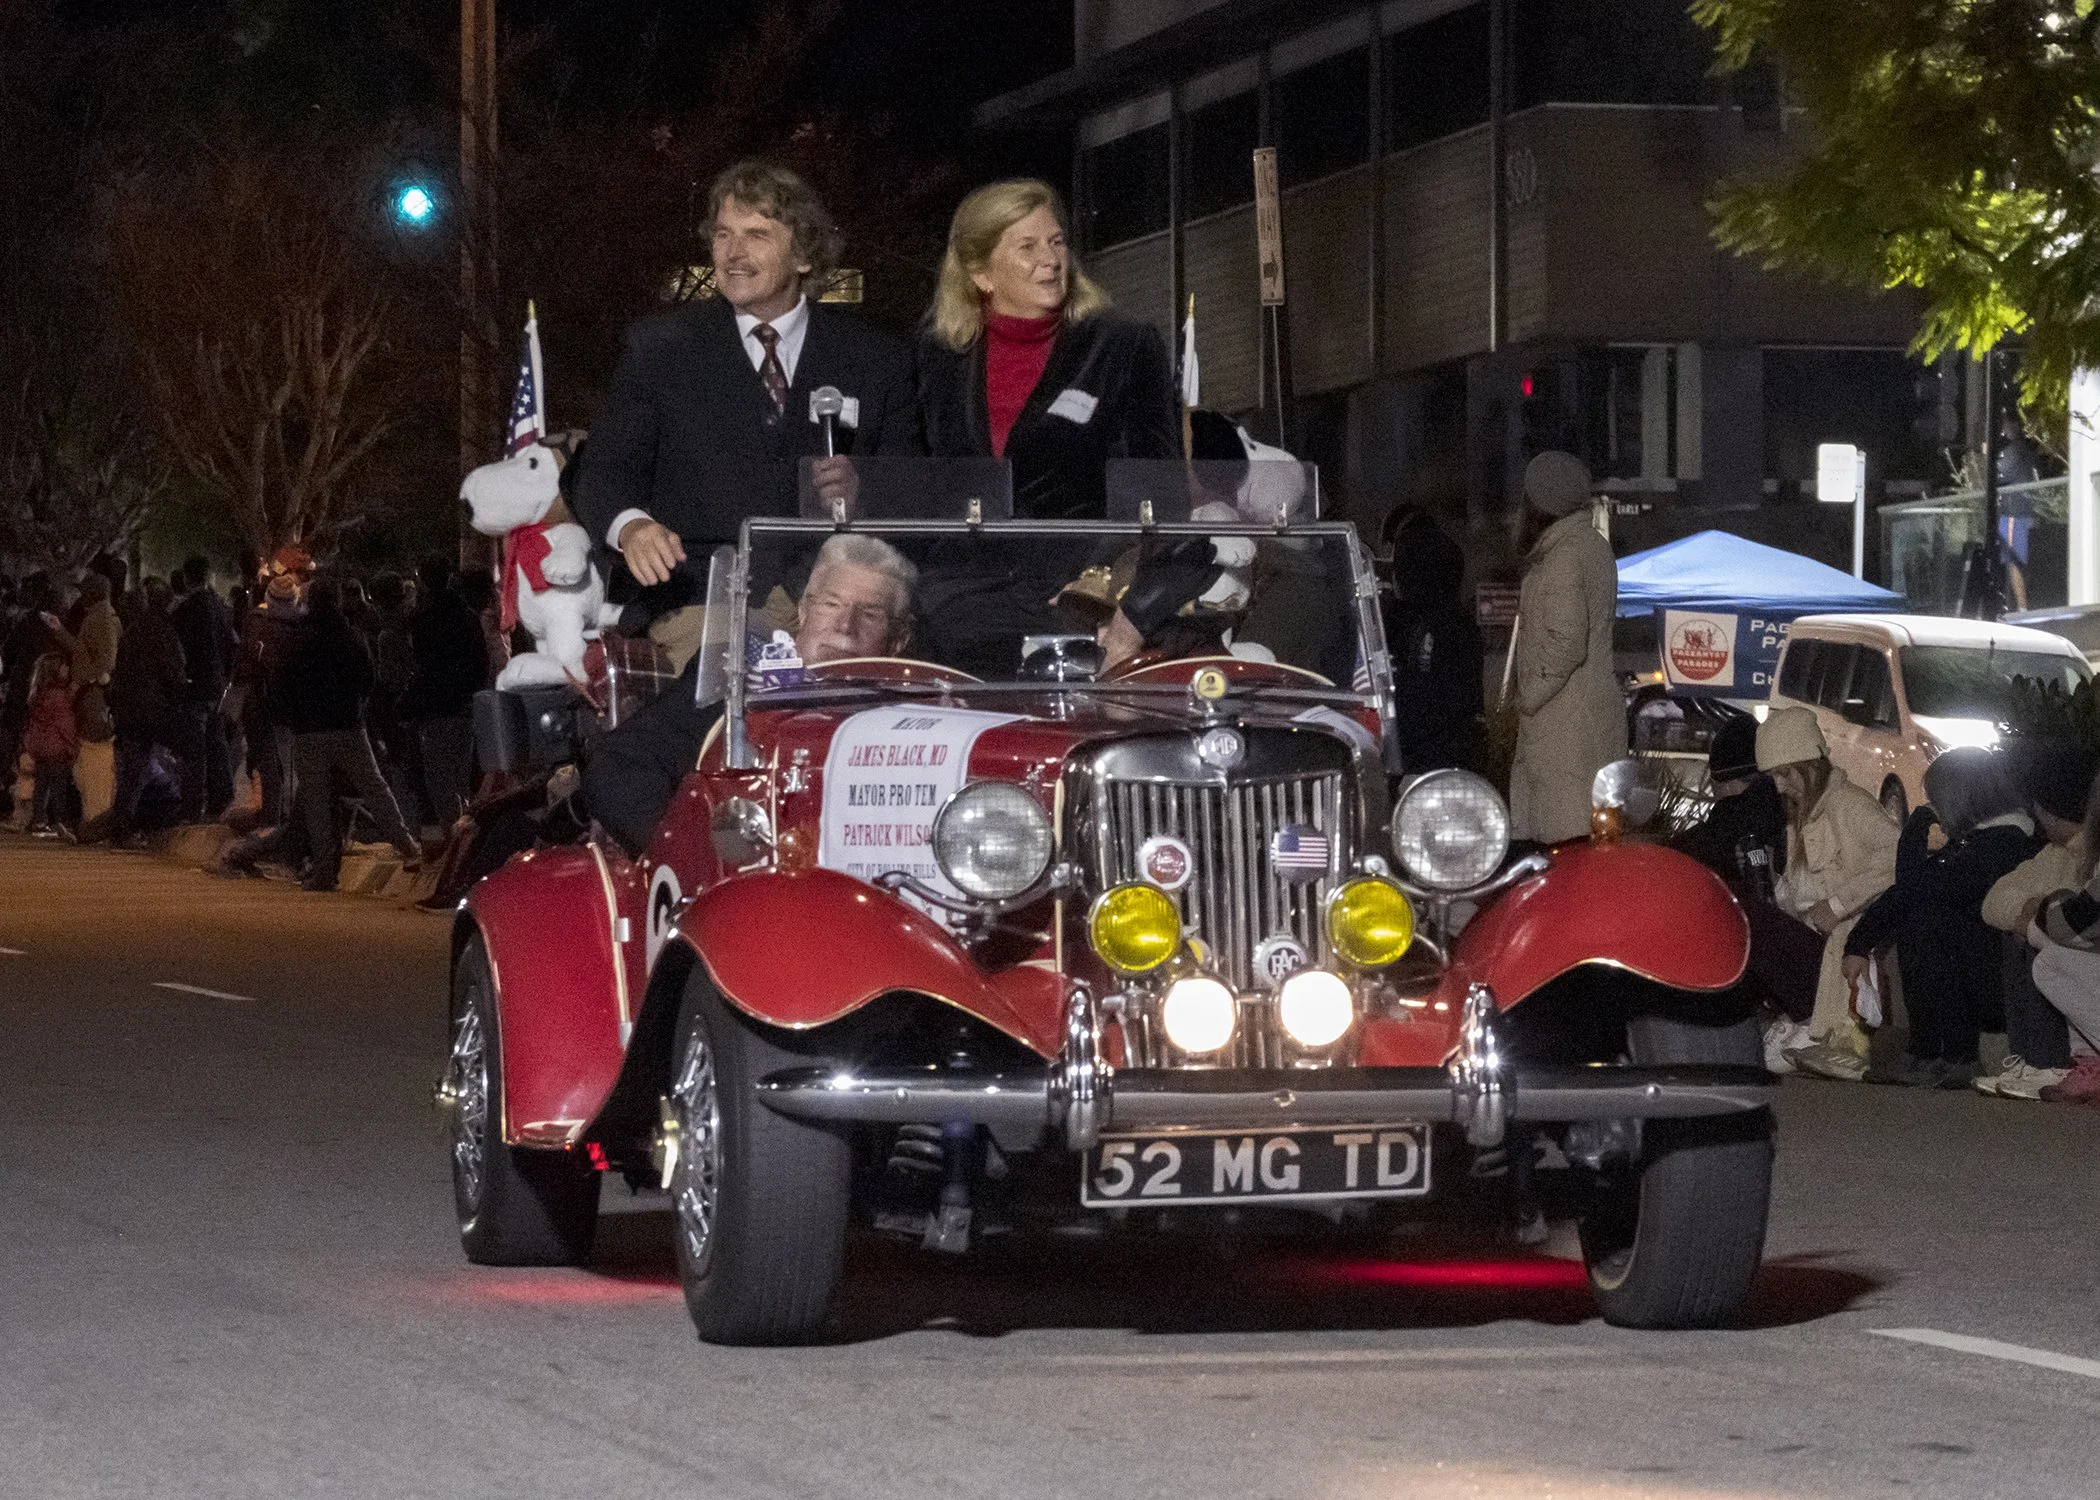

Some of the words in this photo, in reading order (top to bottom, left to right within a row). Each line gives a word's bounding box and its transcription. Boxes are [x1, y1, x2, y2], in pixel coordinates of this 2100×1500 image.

[848, 745, 886, 767] JAMES
[886, 744, 927, 768] BLACK,
[928, 744, 948, 766] MD
[848, 784, 886, 806] MAYOR
[888, 784, 912, 806] PRO
[914, 784, 937, 806] TEM
[843, 824, 892, 847] PATRICK
[895, 824, 933, 847] WILSO
[1096, 1140, 1182, 1197] 52
[1213, 1136, 1301, 1193] MG
[1333, 1131, 1419, 1188] TD
